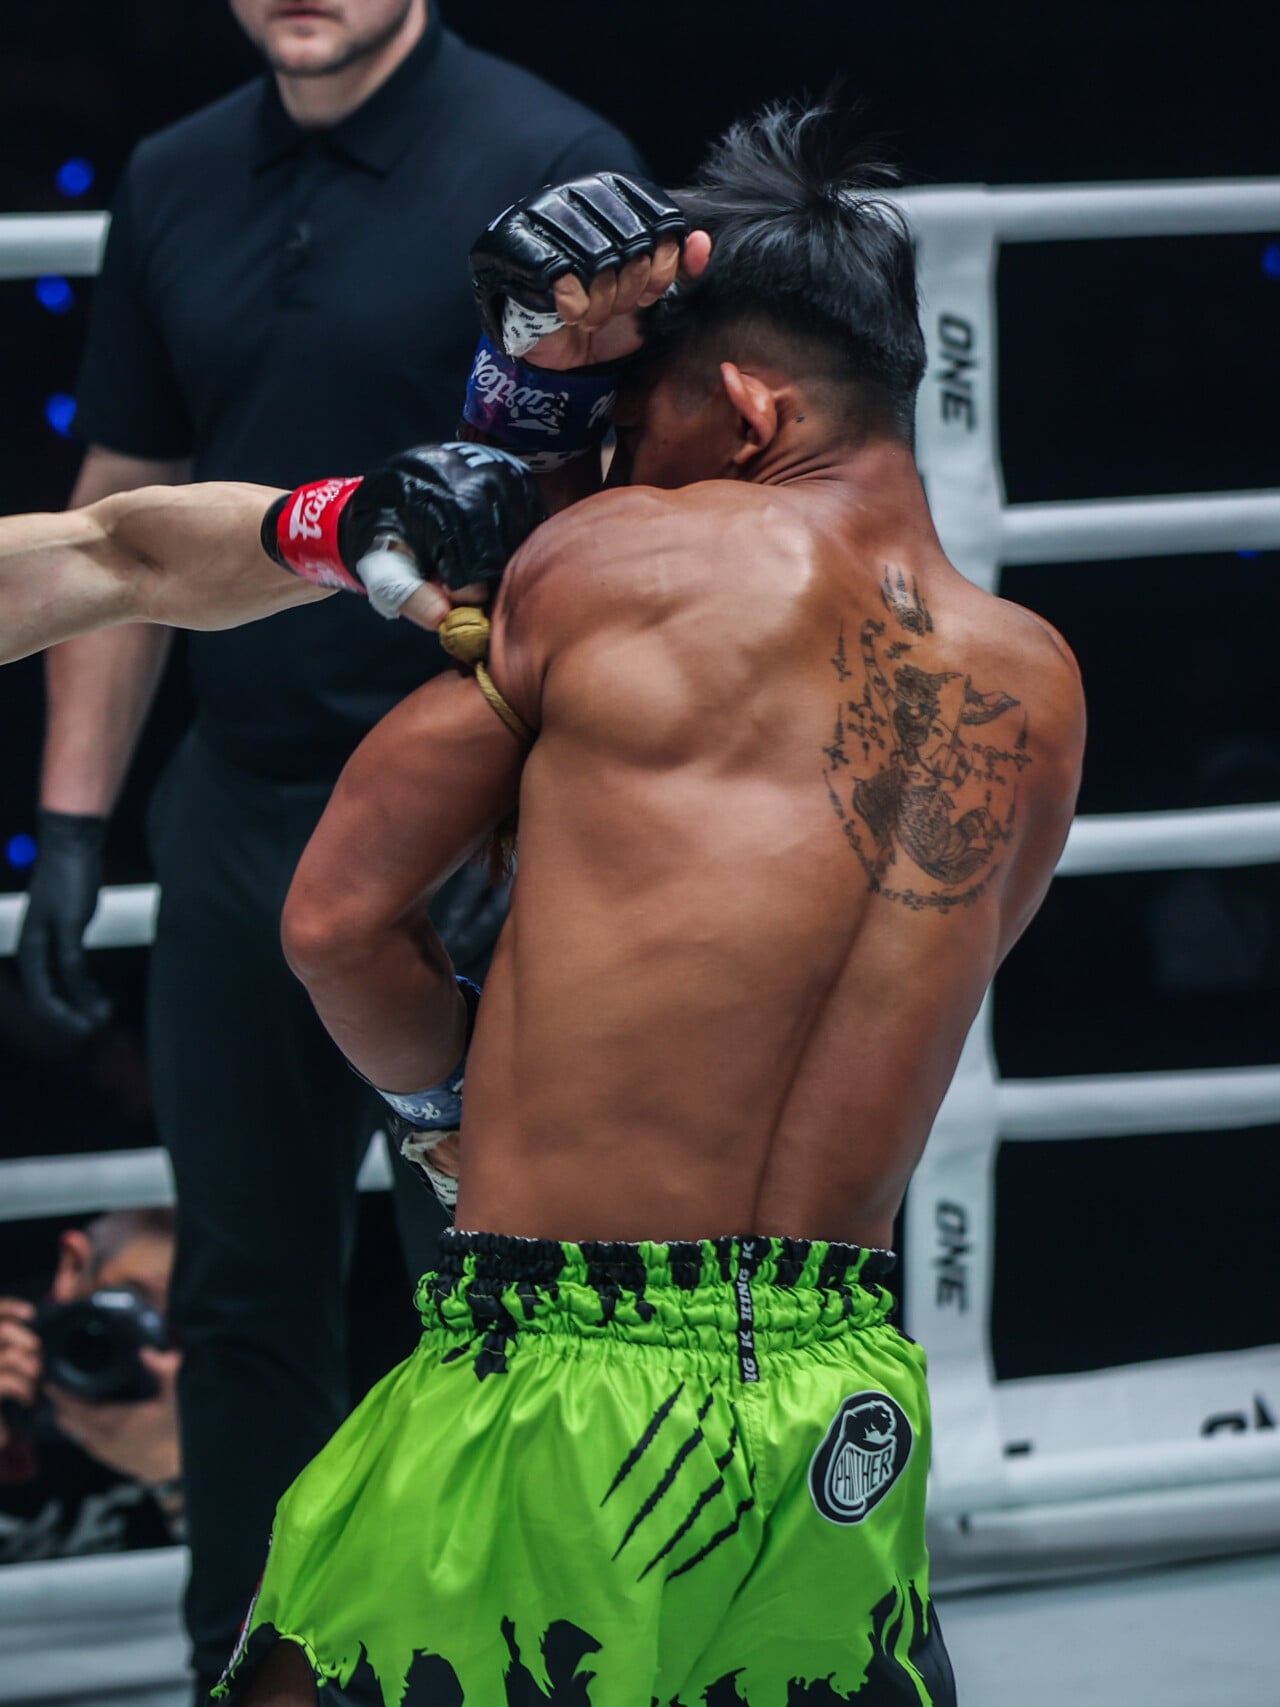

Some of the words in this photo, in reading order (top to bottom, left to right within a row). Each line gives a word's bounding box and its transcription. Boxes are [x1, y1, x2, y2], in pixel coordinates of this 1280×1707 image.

[936, 313, 978, 433] ONE
[933, 1201, 970, 1313] ONE
[834, 1448, 890, 1502] PANTHER
